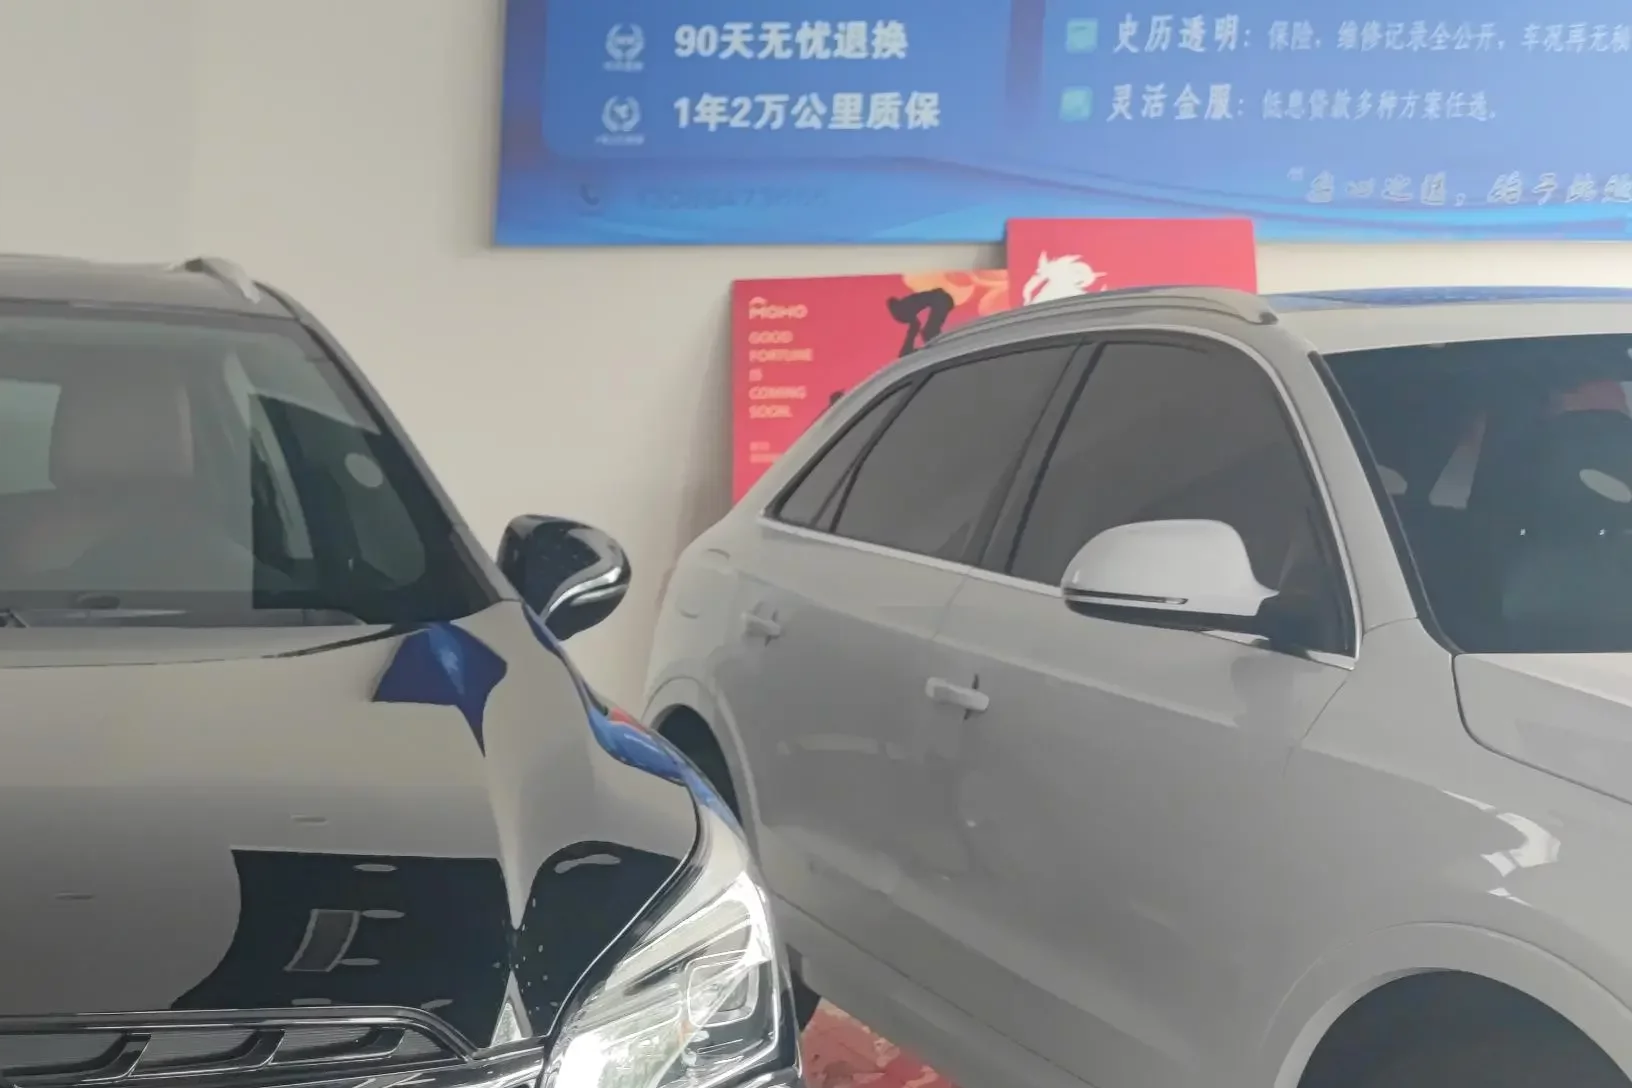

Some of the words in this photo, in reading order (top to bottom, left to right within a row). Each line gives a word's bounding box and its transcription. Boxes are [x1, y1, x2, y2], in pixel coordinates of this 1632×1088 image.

[674, 20, 908, 60] 90天无忧退换
[673, 92, 941, 131] 1年2万公里质保
